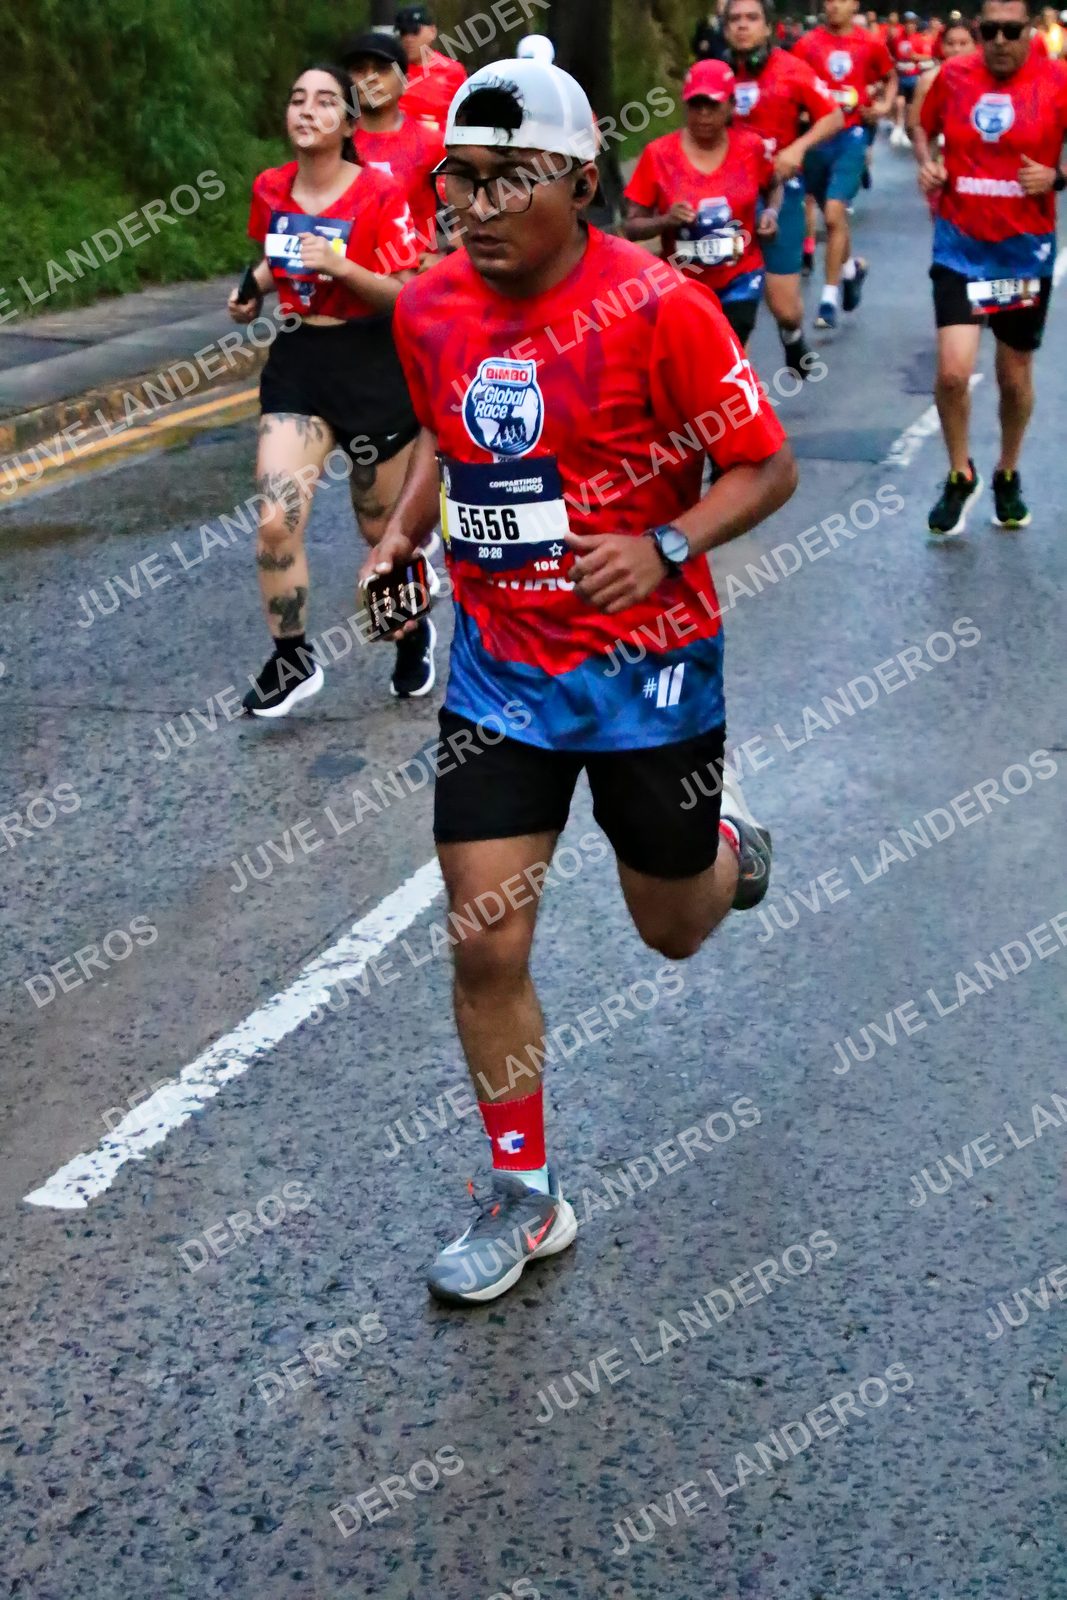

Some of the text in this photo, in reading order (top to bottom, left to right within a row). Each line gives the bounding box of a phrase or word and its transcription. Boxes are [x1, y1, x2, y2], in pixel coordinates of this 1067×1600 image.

[485, 368, 528, 382] BIMBO
[484, 386, 527, 407] Global
[474, 401, 508, 419] Race
[489, 476, 542, 488] COMPARTIMOS
[457, 505, 520, 540] 5556
[534, 560, 560, 571] 10K
